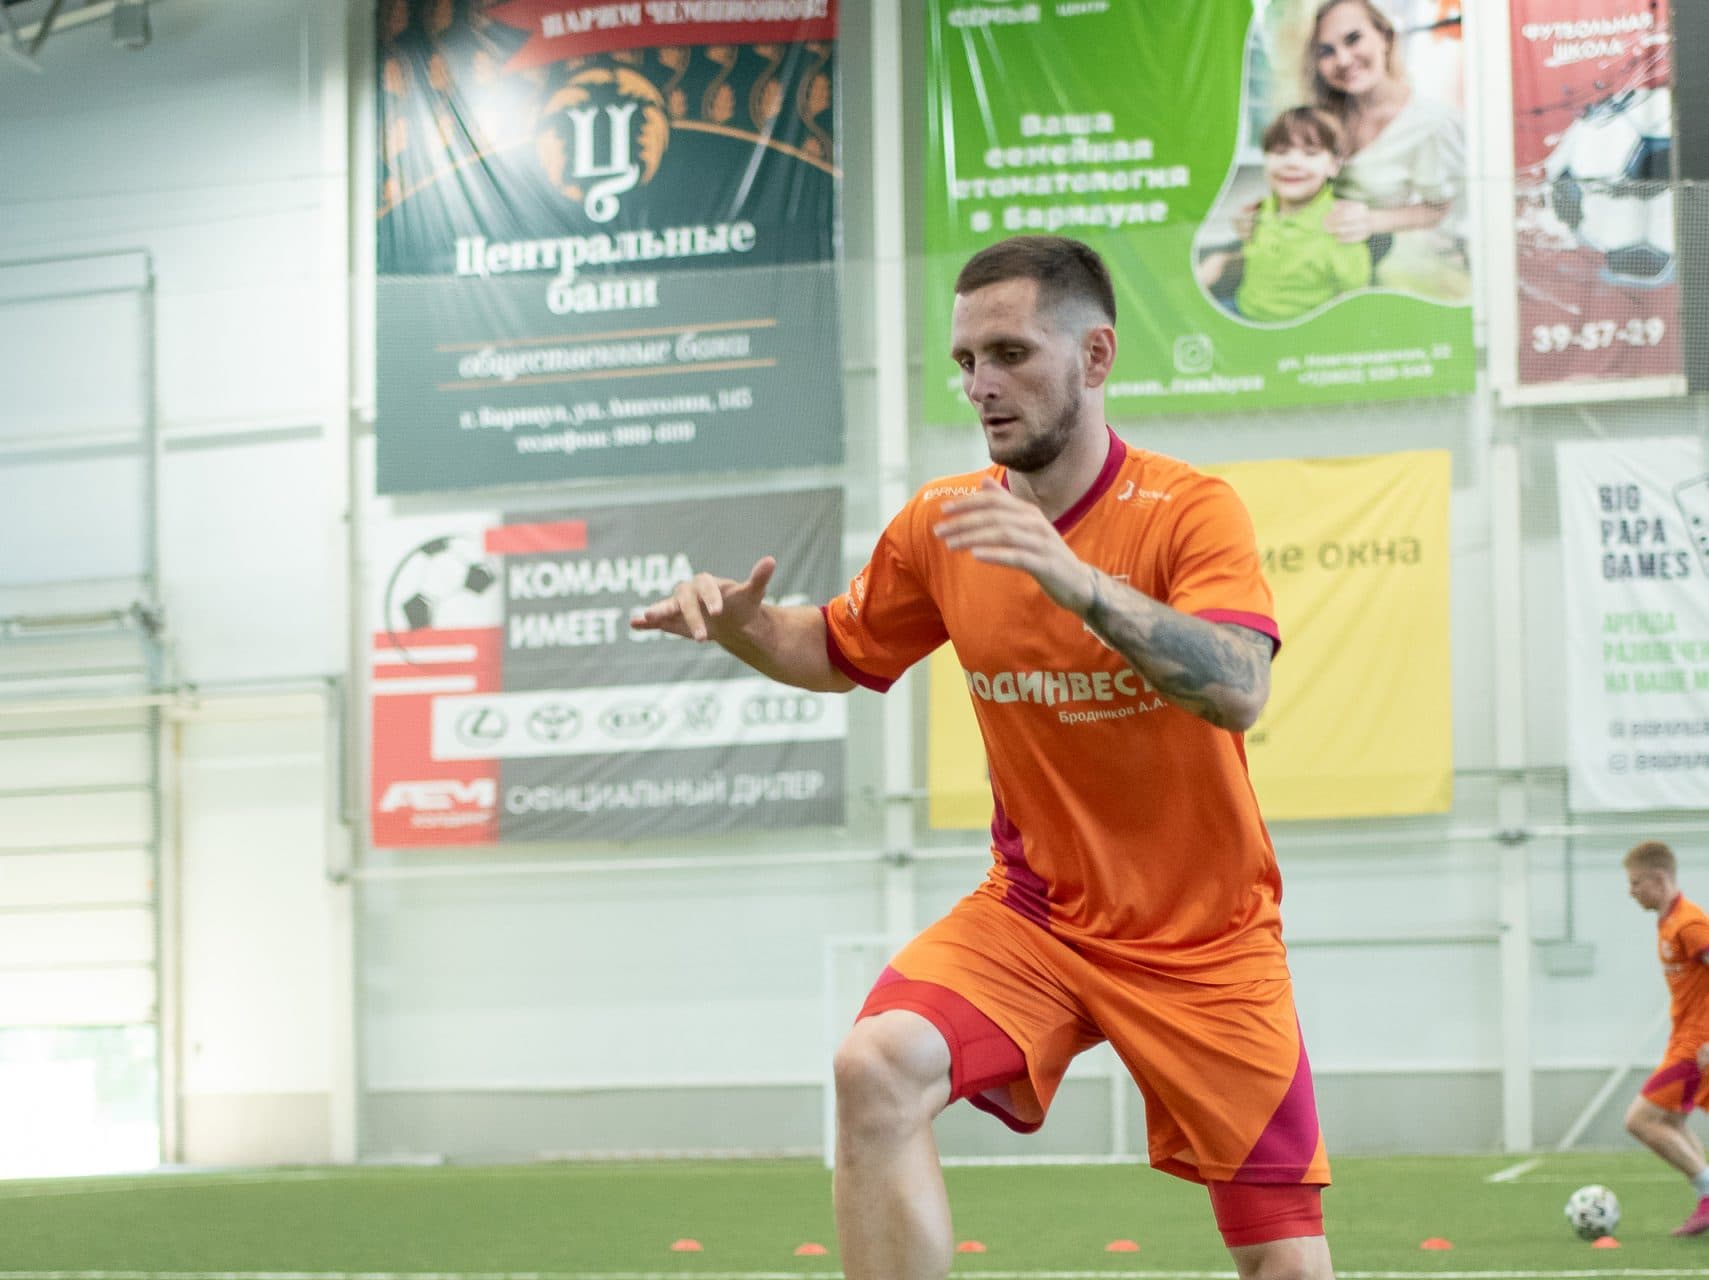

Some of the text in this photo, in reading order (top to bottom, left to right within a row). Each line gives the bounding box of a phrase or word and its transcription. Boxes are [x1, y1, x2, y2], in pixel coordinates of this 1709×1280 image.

[455, 220, 757, 284] Центральные
[546, 275, 660, 316] бани
[1601, 517, 1667, 547] PAPA
[1317, 535, 1423, 571] окна
[1602, 550, 1691, 581] GAMES
[509, 552, 694, 600] КОМАНДА
[509, 605, 622, 650] ИМЕЕТ
[964, 668, 1153, 707] ОДИНВЕС
[1058, 705, 1135, 726] Бродников
